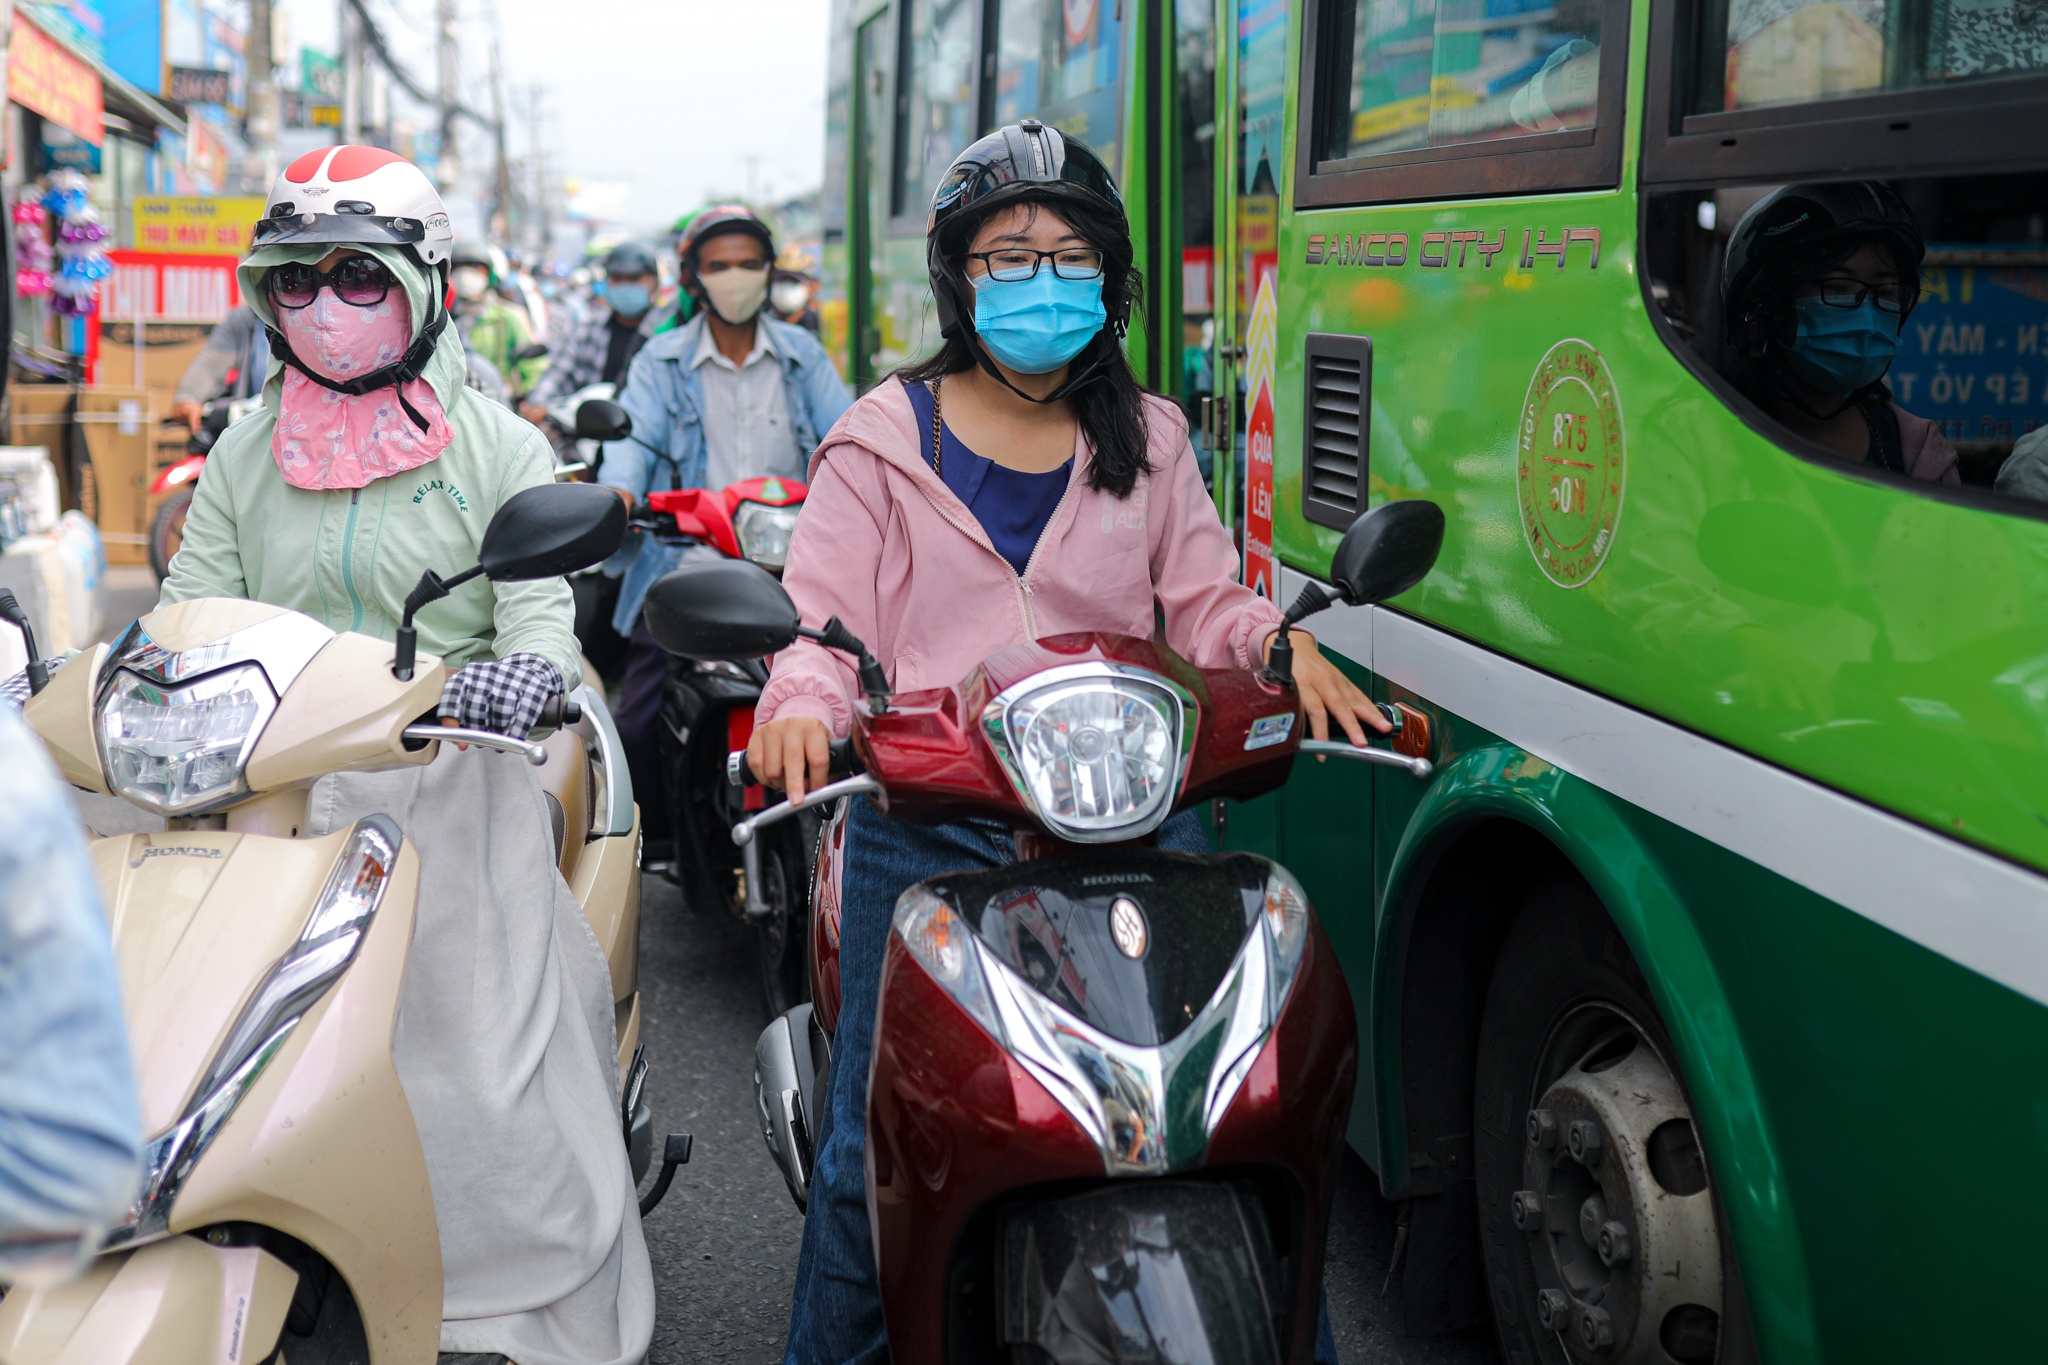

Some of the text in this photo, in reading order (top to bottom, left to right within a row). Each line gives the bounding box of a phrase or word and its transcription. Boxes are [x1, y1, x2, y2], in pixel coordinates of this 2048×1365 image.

[1305, 232, 1409, 267] SAMCO
[1420, 227, 1506, 268] CITY
[413, 480, 468, 512] RELAX TIME
[1252, 480, 1273, 522] LÊN
[142, 847, 224, 859] HONDA
[1082, 872, 1154, 887] HONDA
